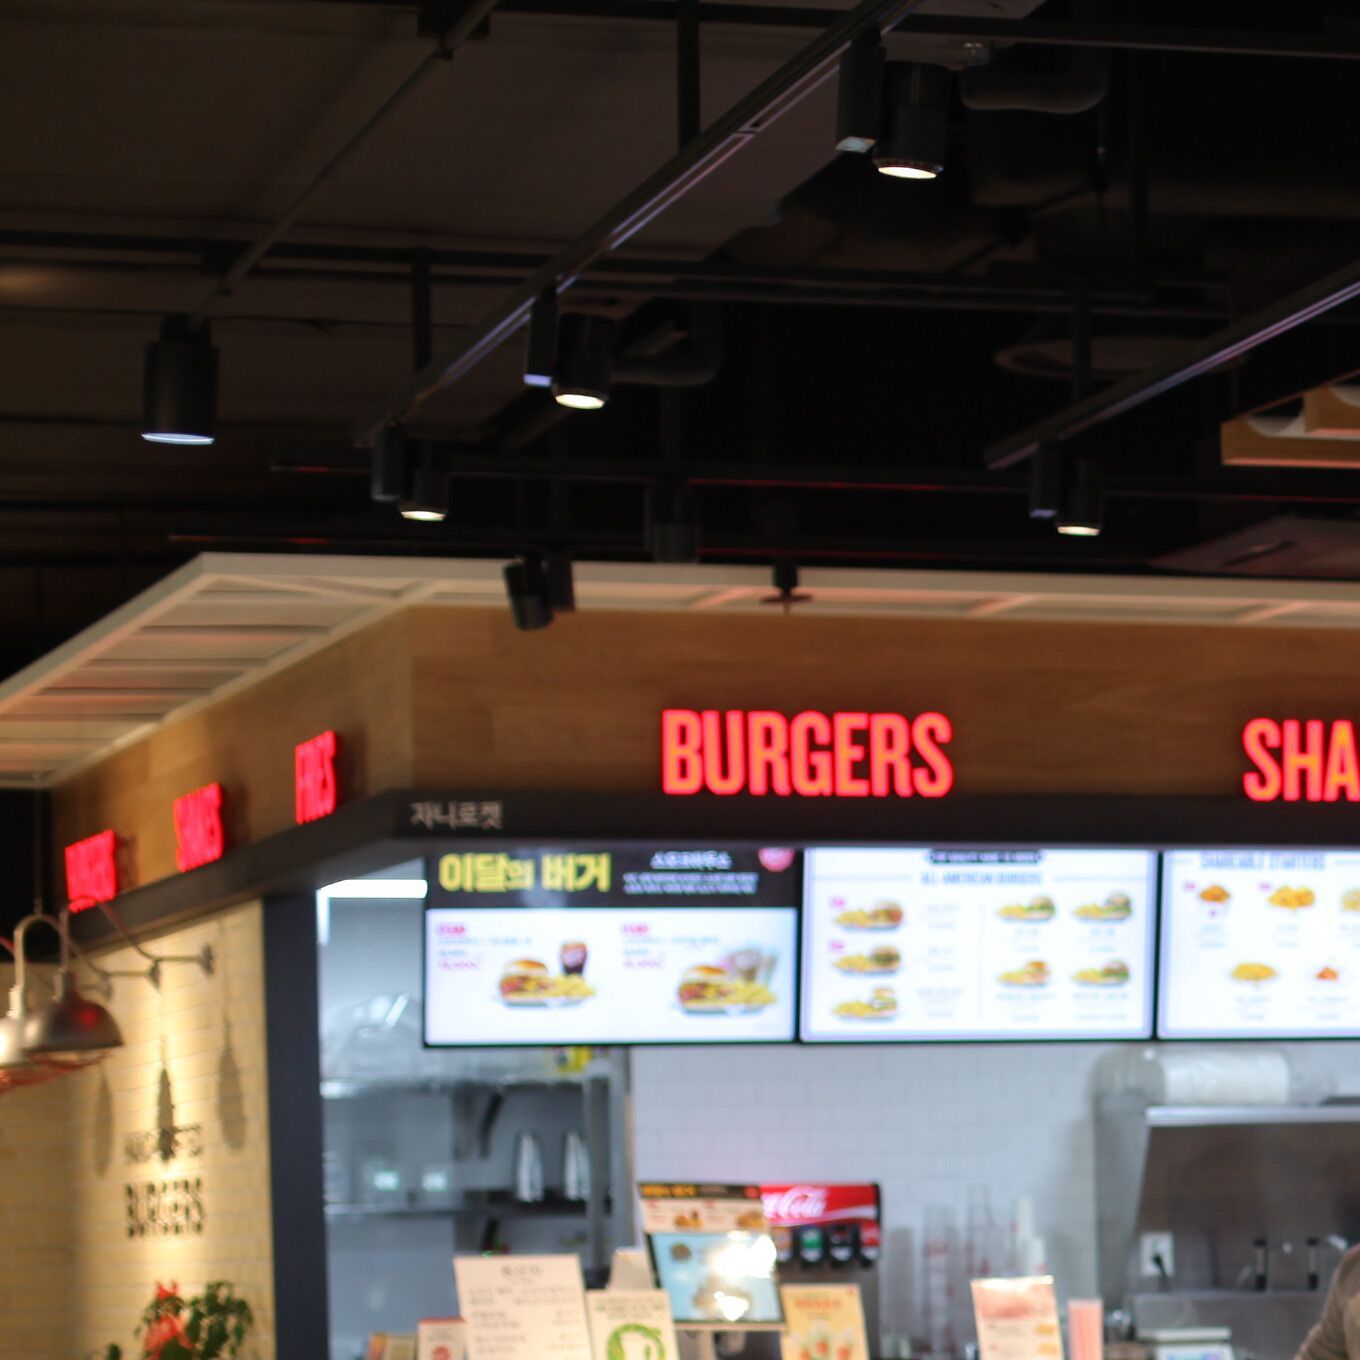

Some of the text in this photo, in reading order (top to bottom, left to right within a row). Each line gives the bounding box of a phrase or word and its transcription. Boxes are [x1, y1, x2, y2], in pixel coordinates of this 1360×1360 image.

[662, 709, 954, 797] BURGERS
[410, 800, 504, 832] 자니로켓
[438, 853, 534, 893] 이달의
[541, 852, 611, 893] 버거
